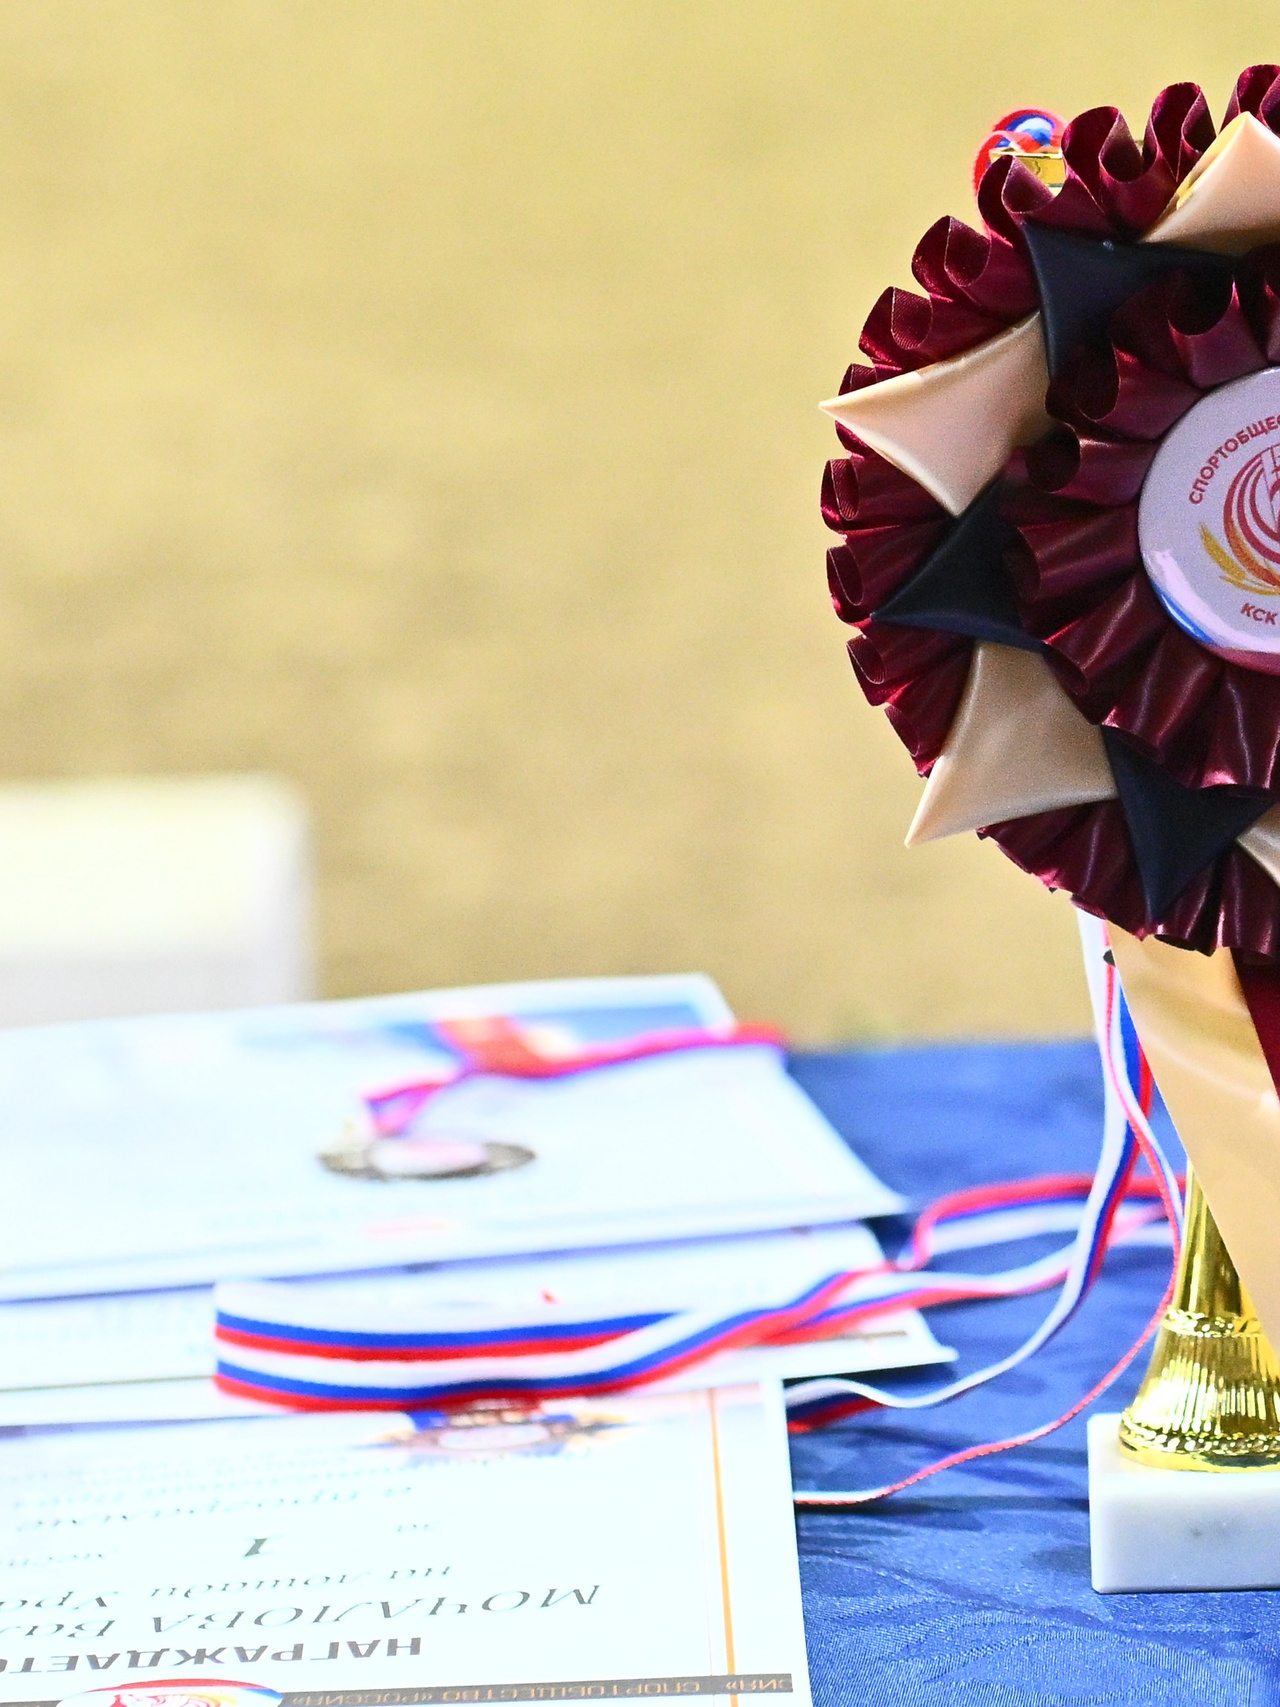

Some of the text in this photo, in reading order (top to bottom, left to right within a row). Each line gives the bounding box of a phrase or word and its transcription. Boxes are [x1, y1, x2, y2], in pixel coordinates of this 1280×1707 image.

[1240, 602, 1277, 626] КСК
[243, 1535, 285, 1558] 1
[152, 1584, 602, 1633] МОЧАЛОВА
[0, 1637, 422, 1674] НАГРАЖДАЕТ
